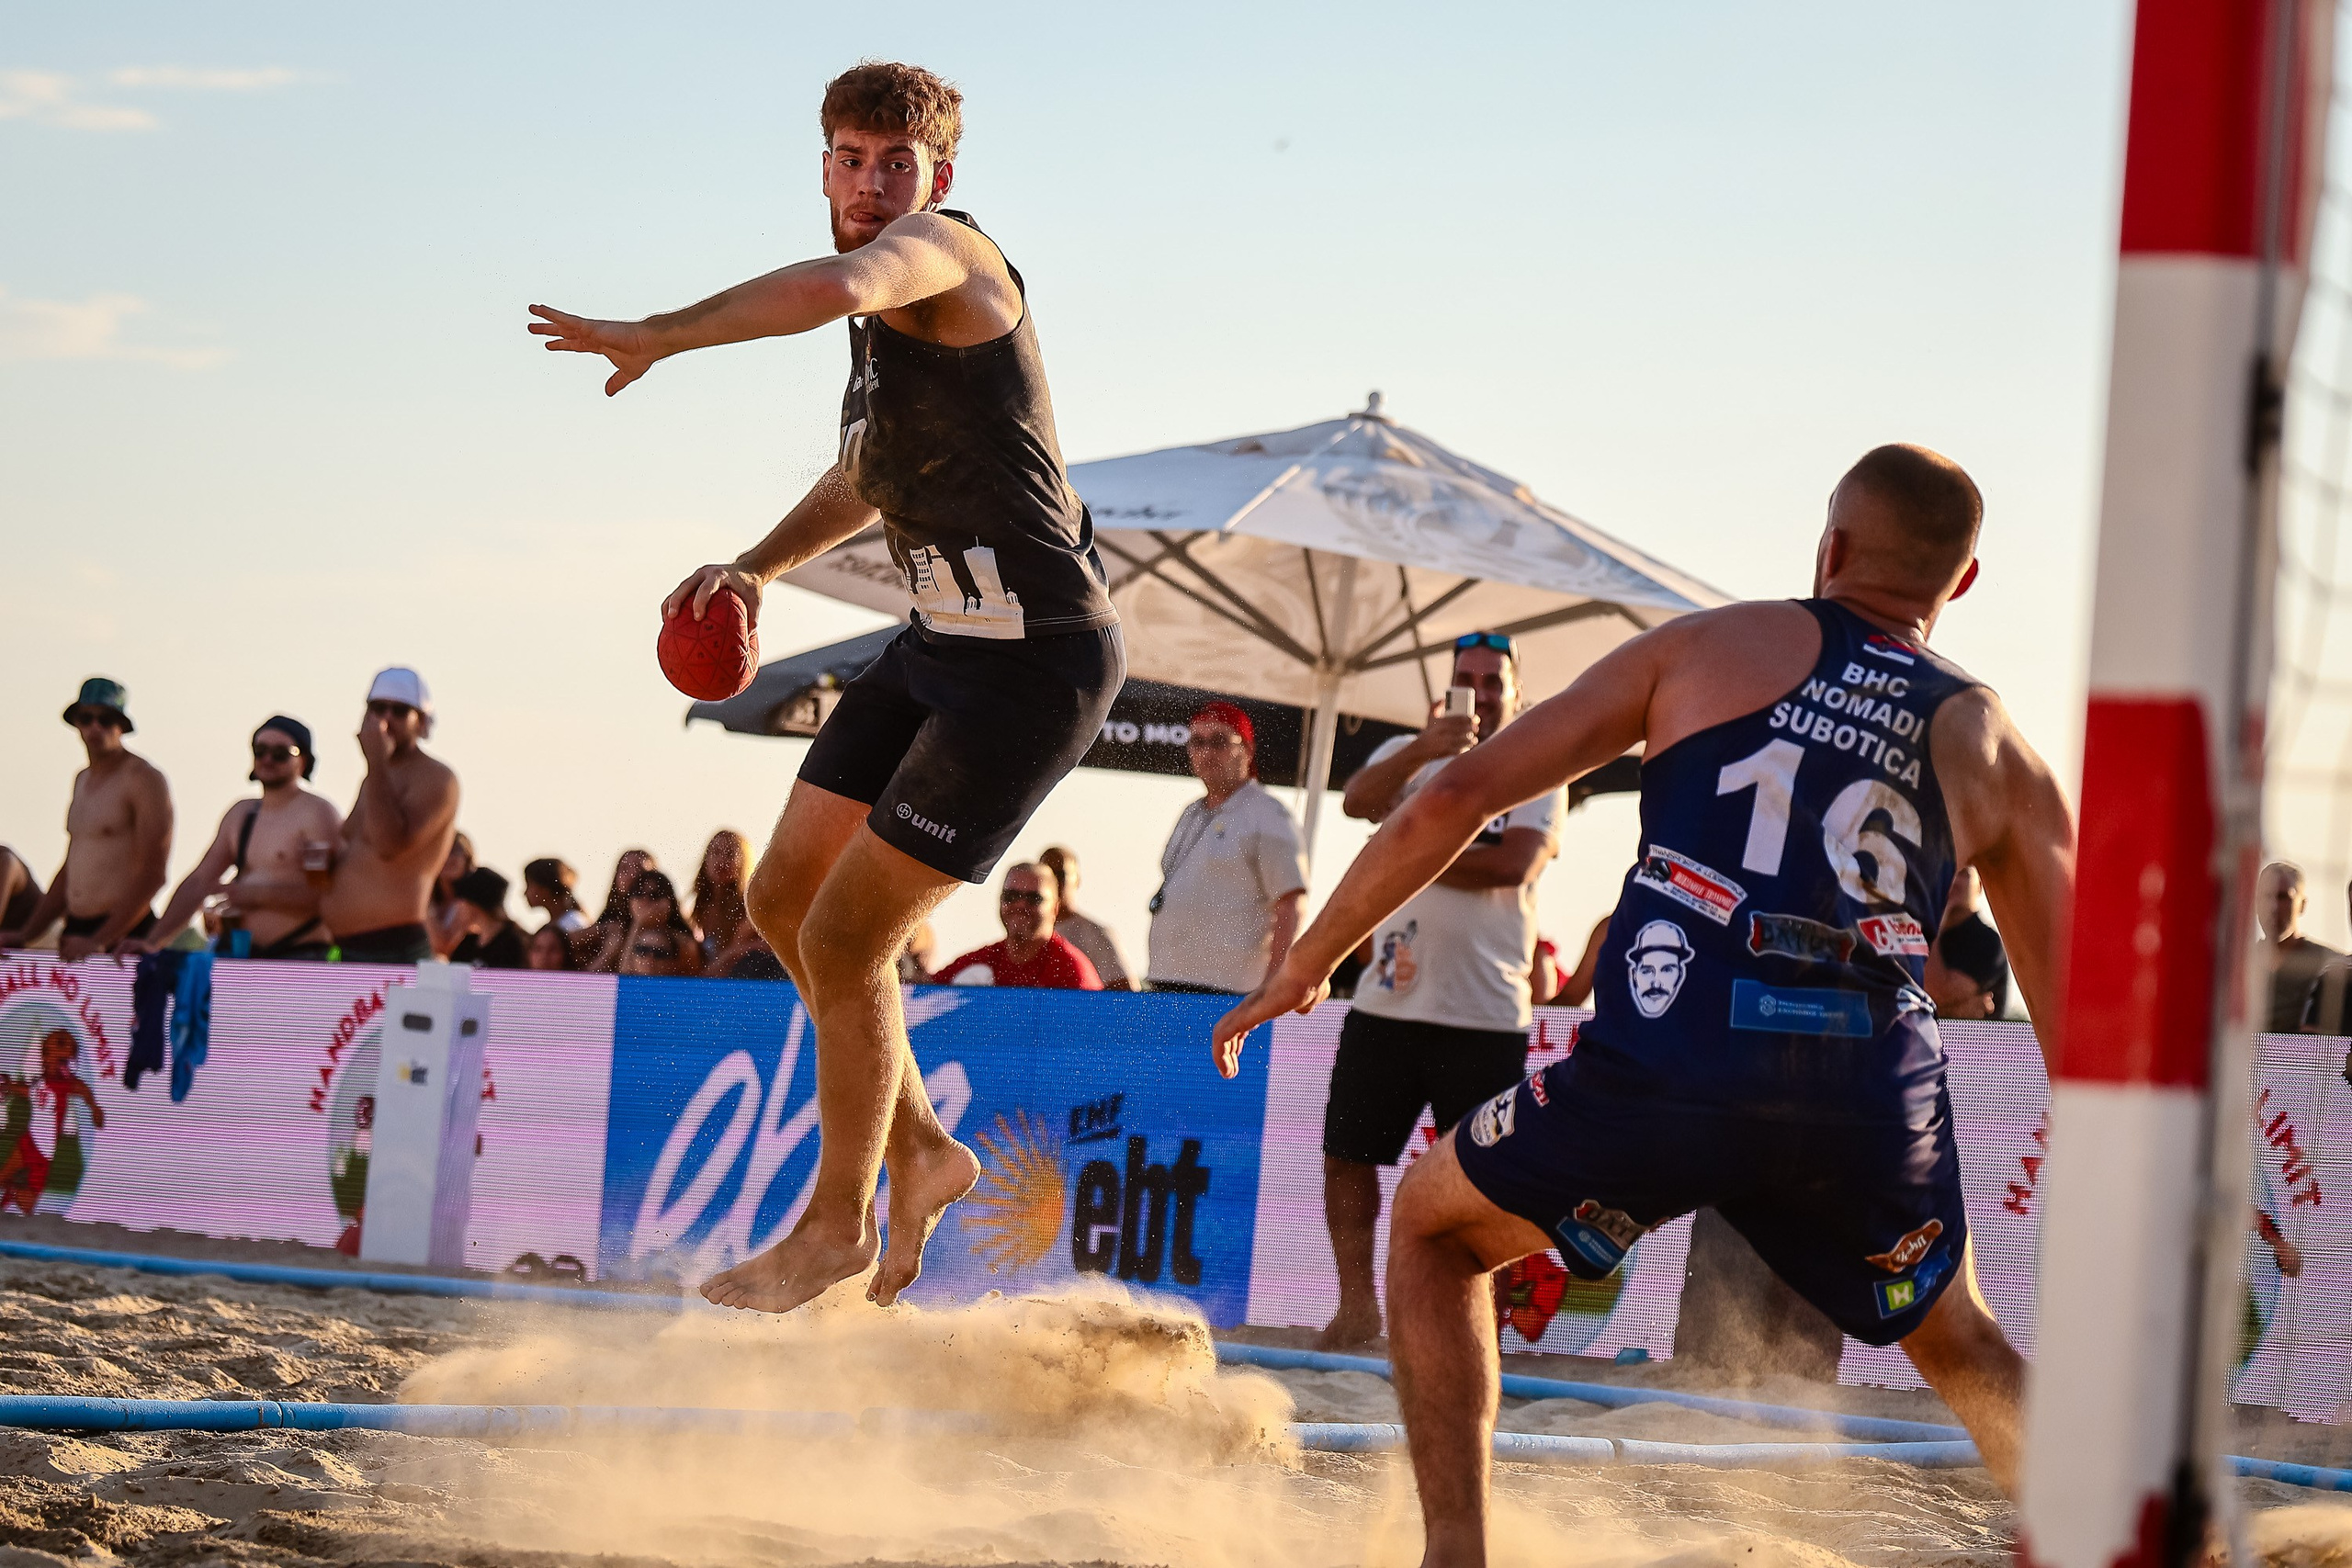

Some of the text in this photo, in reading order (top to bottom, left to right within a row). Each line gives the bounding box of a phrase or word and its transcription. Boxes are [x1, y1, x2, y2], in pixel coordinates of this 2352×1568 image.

[1801, 676, 1926, 744] NOMADI
[1841, 661, 1910, 698] BHC
[1770, 702, 1923, 791] SUBOTICA
[911, 813, 956, 843] unit
[1716, 738, 1922, 904] 16
[1072, 1135, 1209, 1285] ebt
